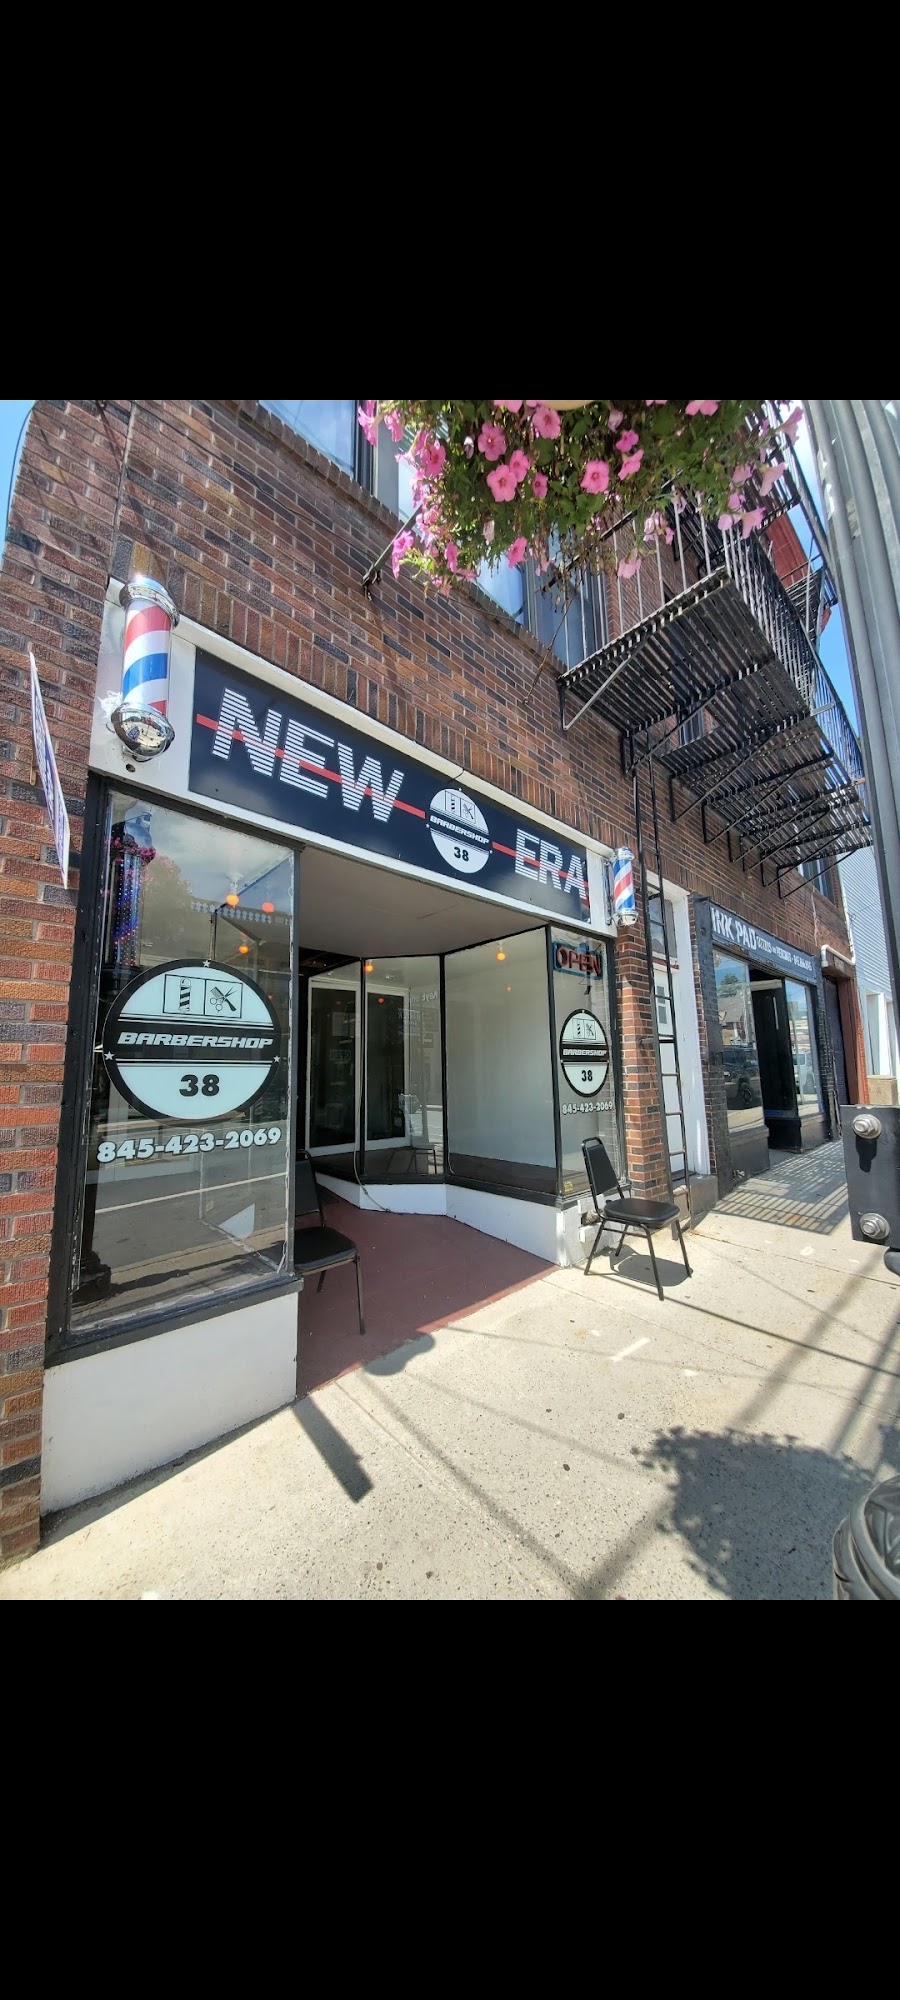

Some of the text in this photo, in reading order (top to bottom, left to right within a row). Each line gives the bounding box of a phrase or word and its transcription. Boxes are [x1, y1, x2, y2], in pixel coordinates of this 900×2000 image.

[211, 687, 588, 900] NEW ERA
[429, 815, 490, 845] BARBERSHOP
[453, 846, 470, 862] 38
[710, 907, 735, 941] INK
[735, 920, 757, 951] PAD
[556, 946, 602, 977] OPEN
[117, 1031, 274, 1049] BARBERSHOP
[562, 1048, 607, 1057] BARBERSHOP
[179, 1074, 220, 1097] 38
[581, 1069, 593, 1082] 38
[562, 1101, 613, 1116] 845-423-2069
[97, 1127, 281, 1164] 845-423-2069
